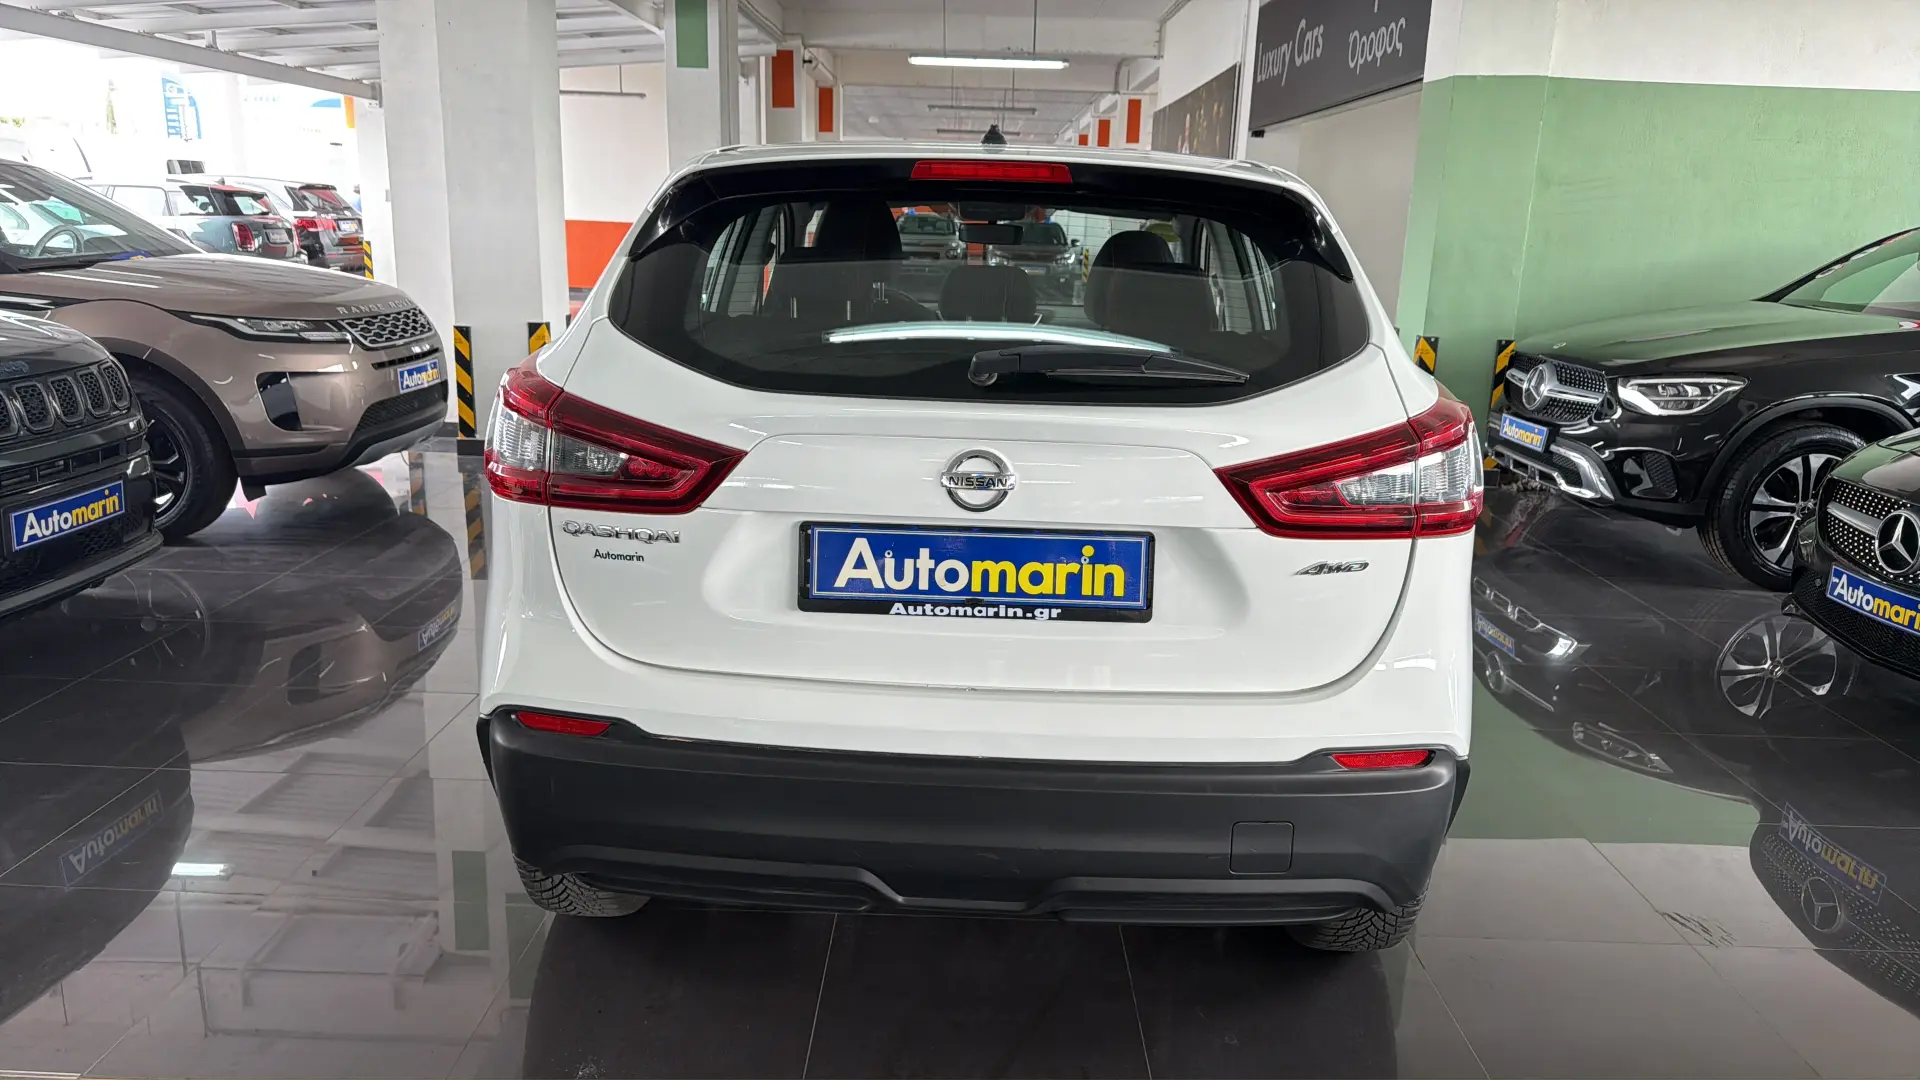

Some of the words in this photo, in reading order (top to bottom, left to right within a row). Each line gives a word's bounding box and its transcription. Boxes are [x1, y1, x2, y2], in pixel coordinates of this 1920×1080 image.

[1256, 41, 1293, 87] Luxury
[1294, 18, 1324, 67] Cars
[336, 303, 385, 315] RANGE
[948, 476, 1008, 488] NISSAN
[22, 489, 120, 543] Automarin
[562, 520, 680, 544] QASHQAI
[594, 549, 645, 562] Automarin
[833, 537, 1126, 597] Automarin
[1292, 559, 1370, 576] 4WD
[889, 602, 1063, 621] Automarin.gr
